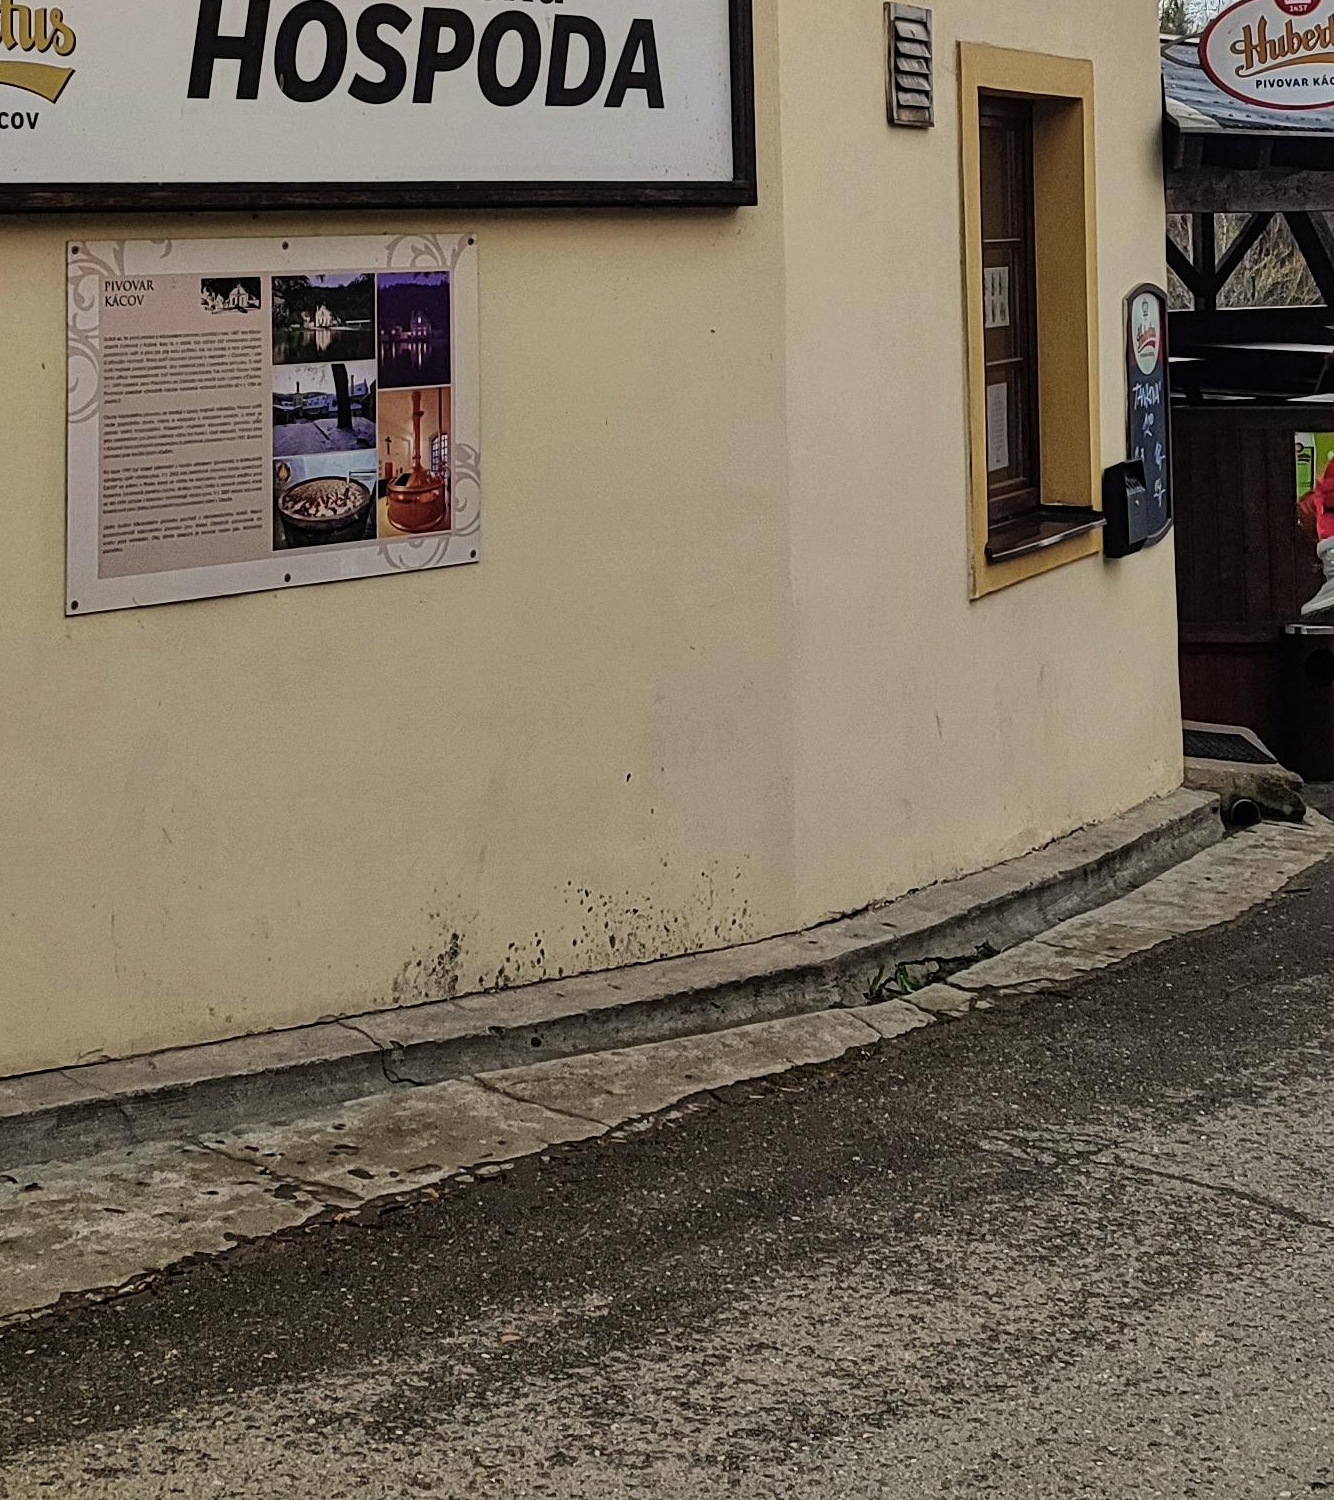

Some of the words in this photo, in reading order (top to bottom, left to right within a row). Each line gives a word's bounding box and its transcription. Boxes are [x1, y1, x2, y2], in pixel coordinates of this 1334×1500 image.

[1255, 77, 1309, 89] PIVOVAR
[104, 279, 155, 293] PIVOVAR
[104, 293, 145, 307] KÁCOV
